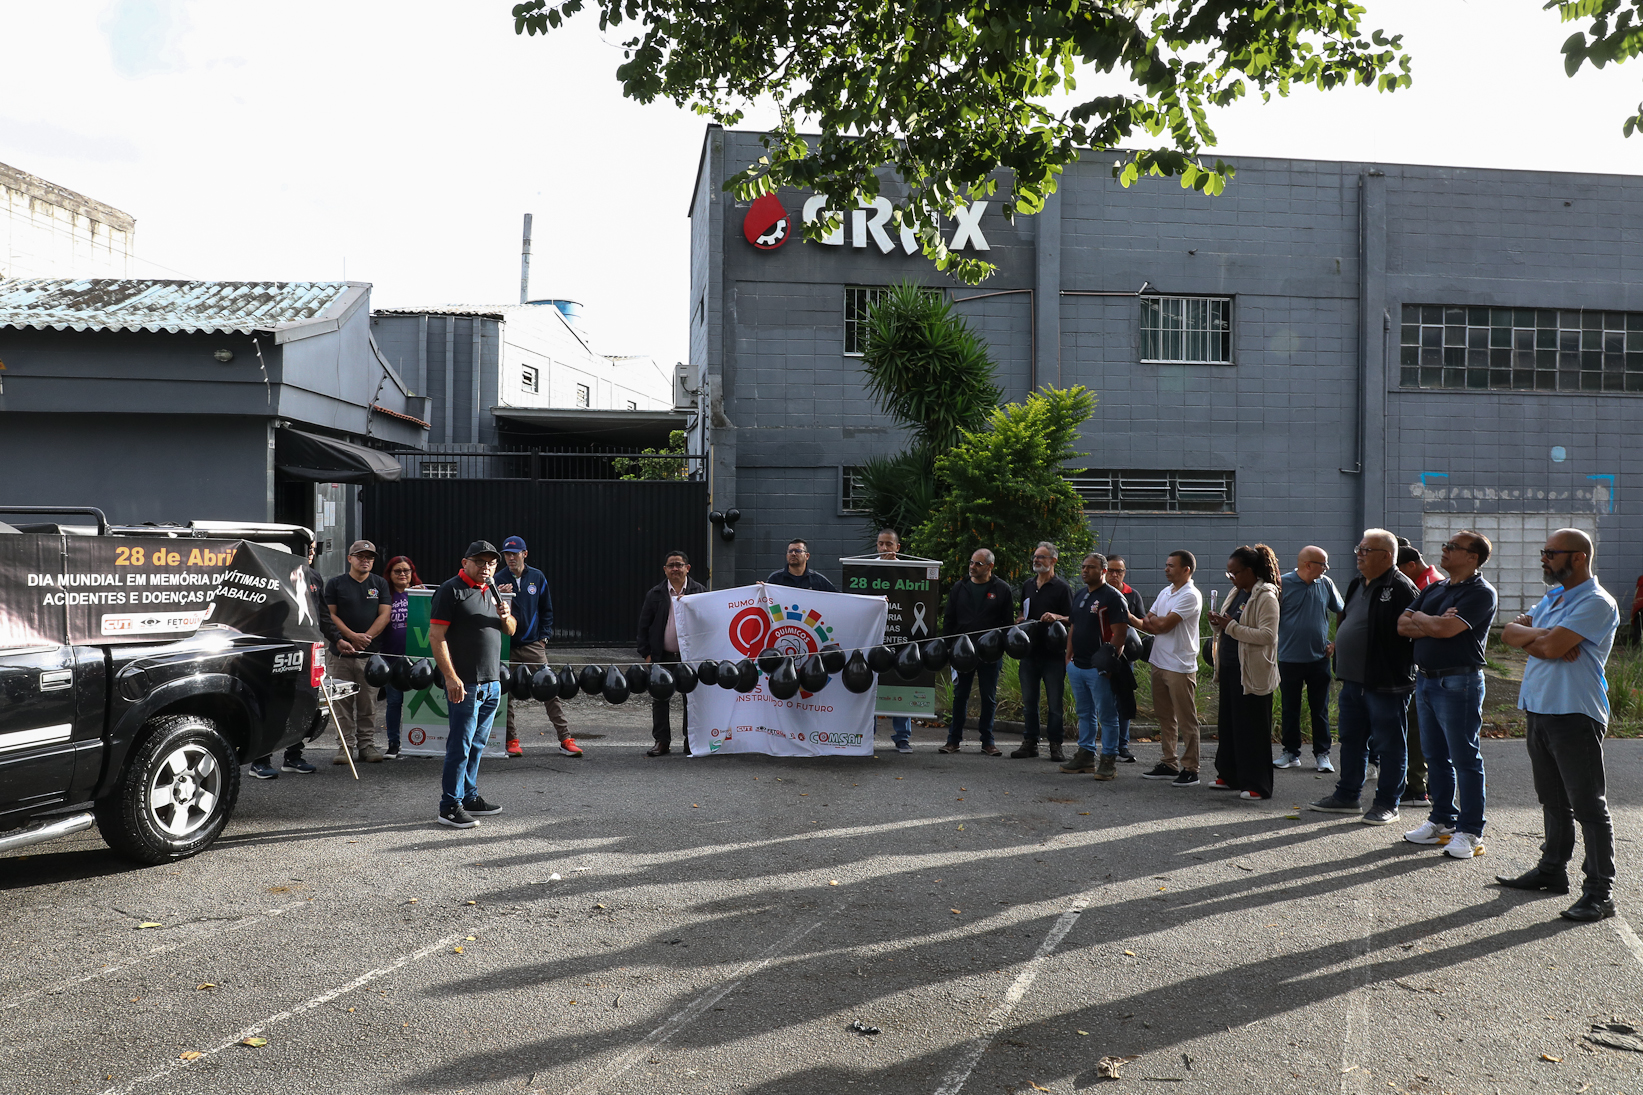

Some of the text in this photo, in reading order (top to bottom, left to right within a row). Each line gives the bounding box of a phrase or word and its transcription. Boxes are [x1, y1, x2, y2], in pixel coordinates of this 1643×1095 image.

[114, 546, 145, 566] 28
[152, 547, 181, 566] de
[27, 573, 54, 587] DIA
[57, 573, 123, 587] MUNDIAL
[126, 573, 147, 586] EM
[149, 570, 210, 586] MEMÓRIA
[224, 569, 267, 589] VÍTIMAS
[267, 579, 280, 591] DE
[849, 576, 930, 591] 28 de Abril
[42, 591, 126, 606] ACIDENTES
[130, 592, 139, 604] E
[142, 590, 204, 606] DOENÇAS
[728, 596, 774, 609] RUMO AOS
[105, 619, 131, 631] CUT
[775, 626, 811, 643] QUÍMICOS
[883, 635, 908, 644] ENTES
[796, 702, 834, 713] FUTURO
[809, 730, 863, 747] COMSAT
